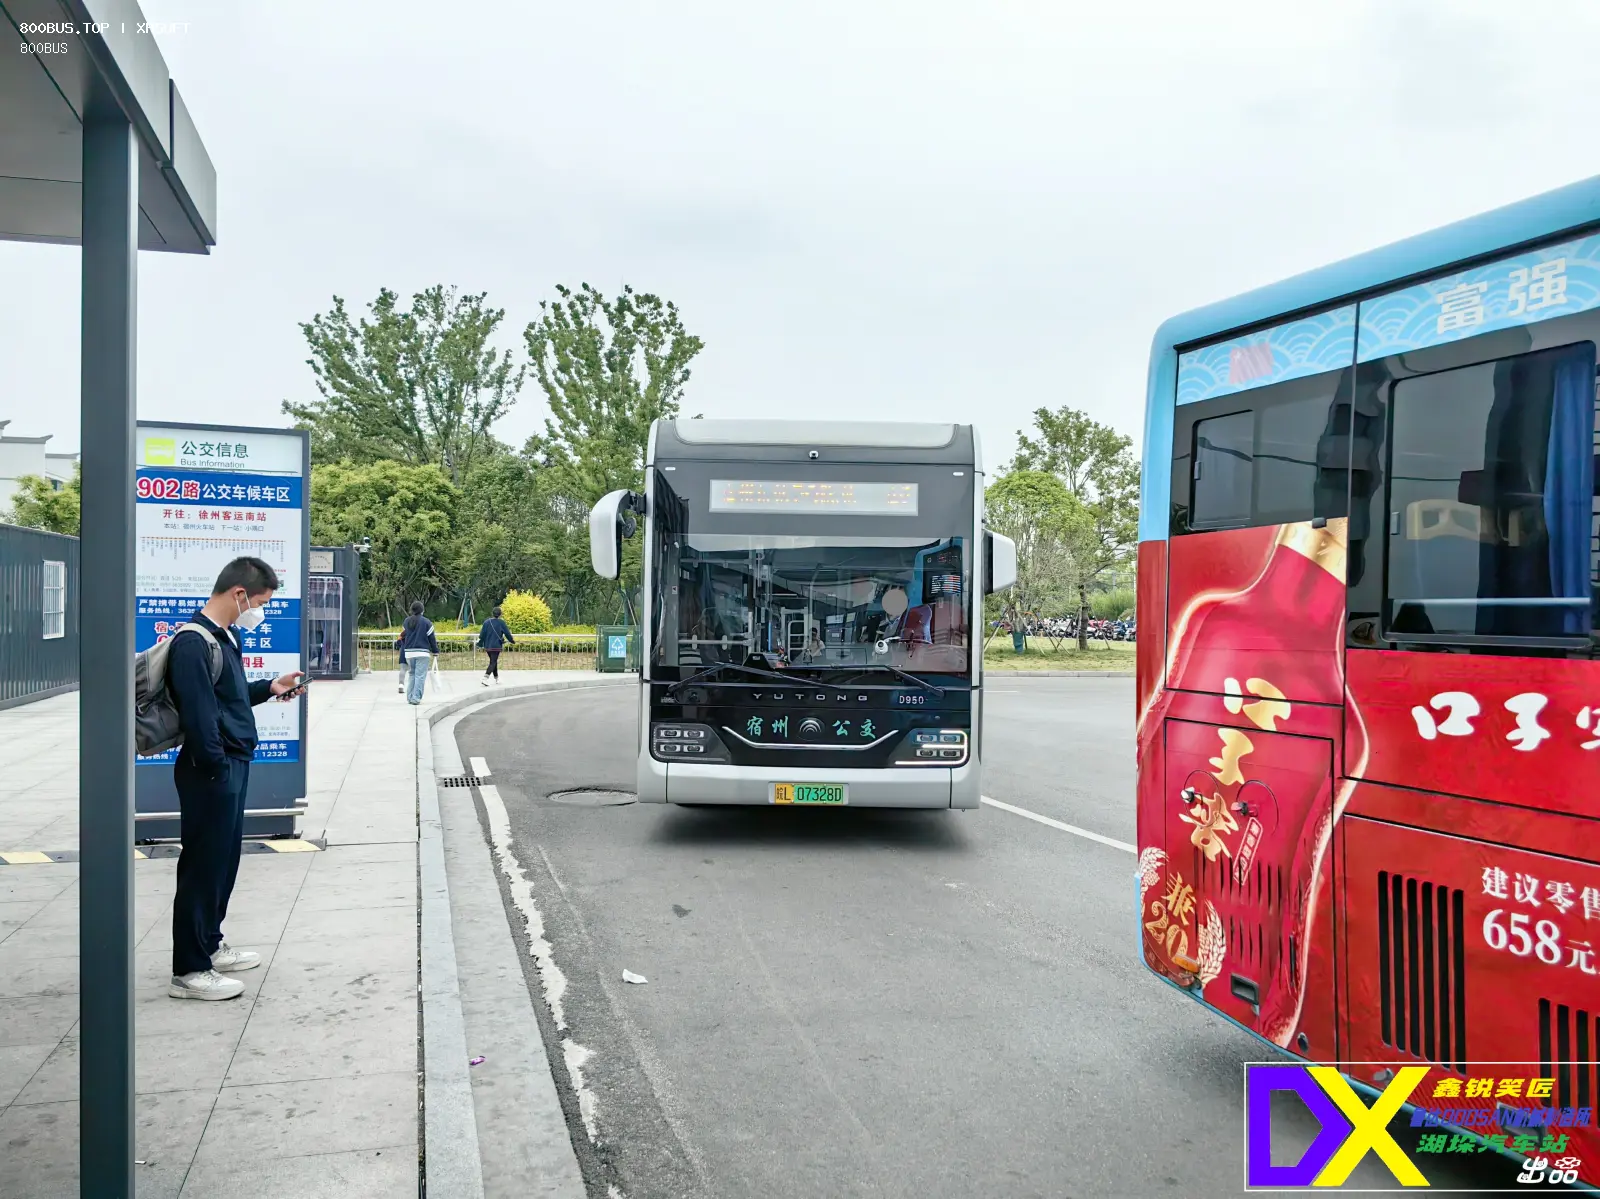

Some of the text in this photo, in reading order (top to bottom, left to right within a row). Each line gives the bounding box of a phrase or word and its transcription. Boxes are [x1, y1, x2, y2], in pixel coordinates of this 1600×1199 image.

[1436, 257, 1568, 334] 富强
[181, 440, 249, 458] 公交信息
[180, 458, 245, 469] Bus Information
[137, 476, 290, 502] 902路公交车候车区
[753, 693, 868, 701] YUTONG
[899, 695, 924, 704] D950
[746, 715, 876, 739] 宿州 公交
[797, 787, 842, 802] 07328D
[1481, 866, 1600, 920] 建议零售
[1482, 908, 1597, 975] 658元
